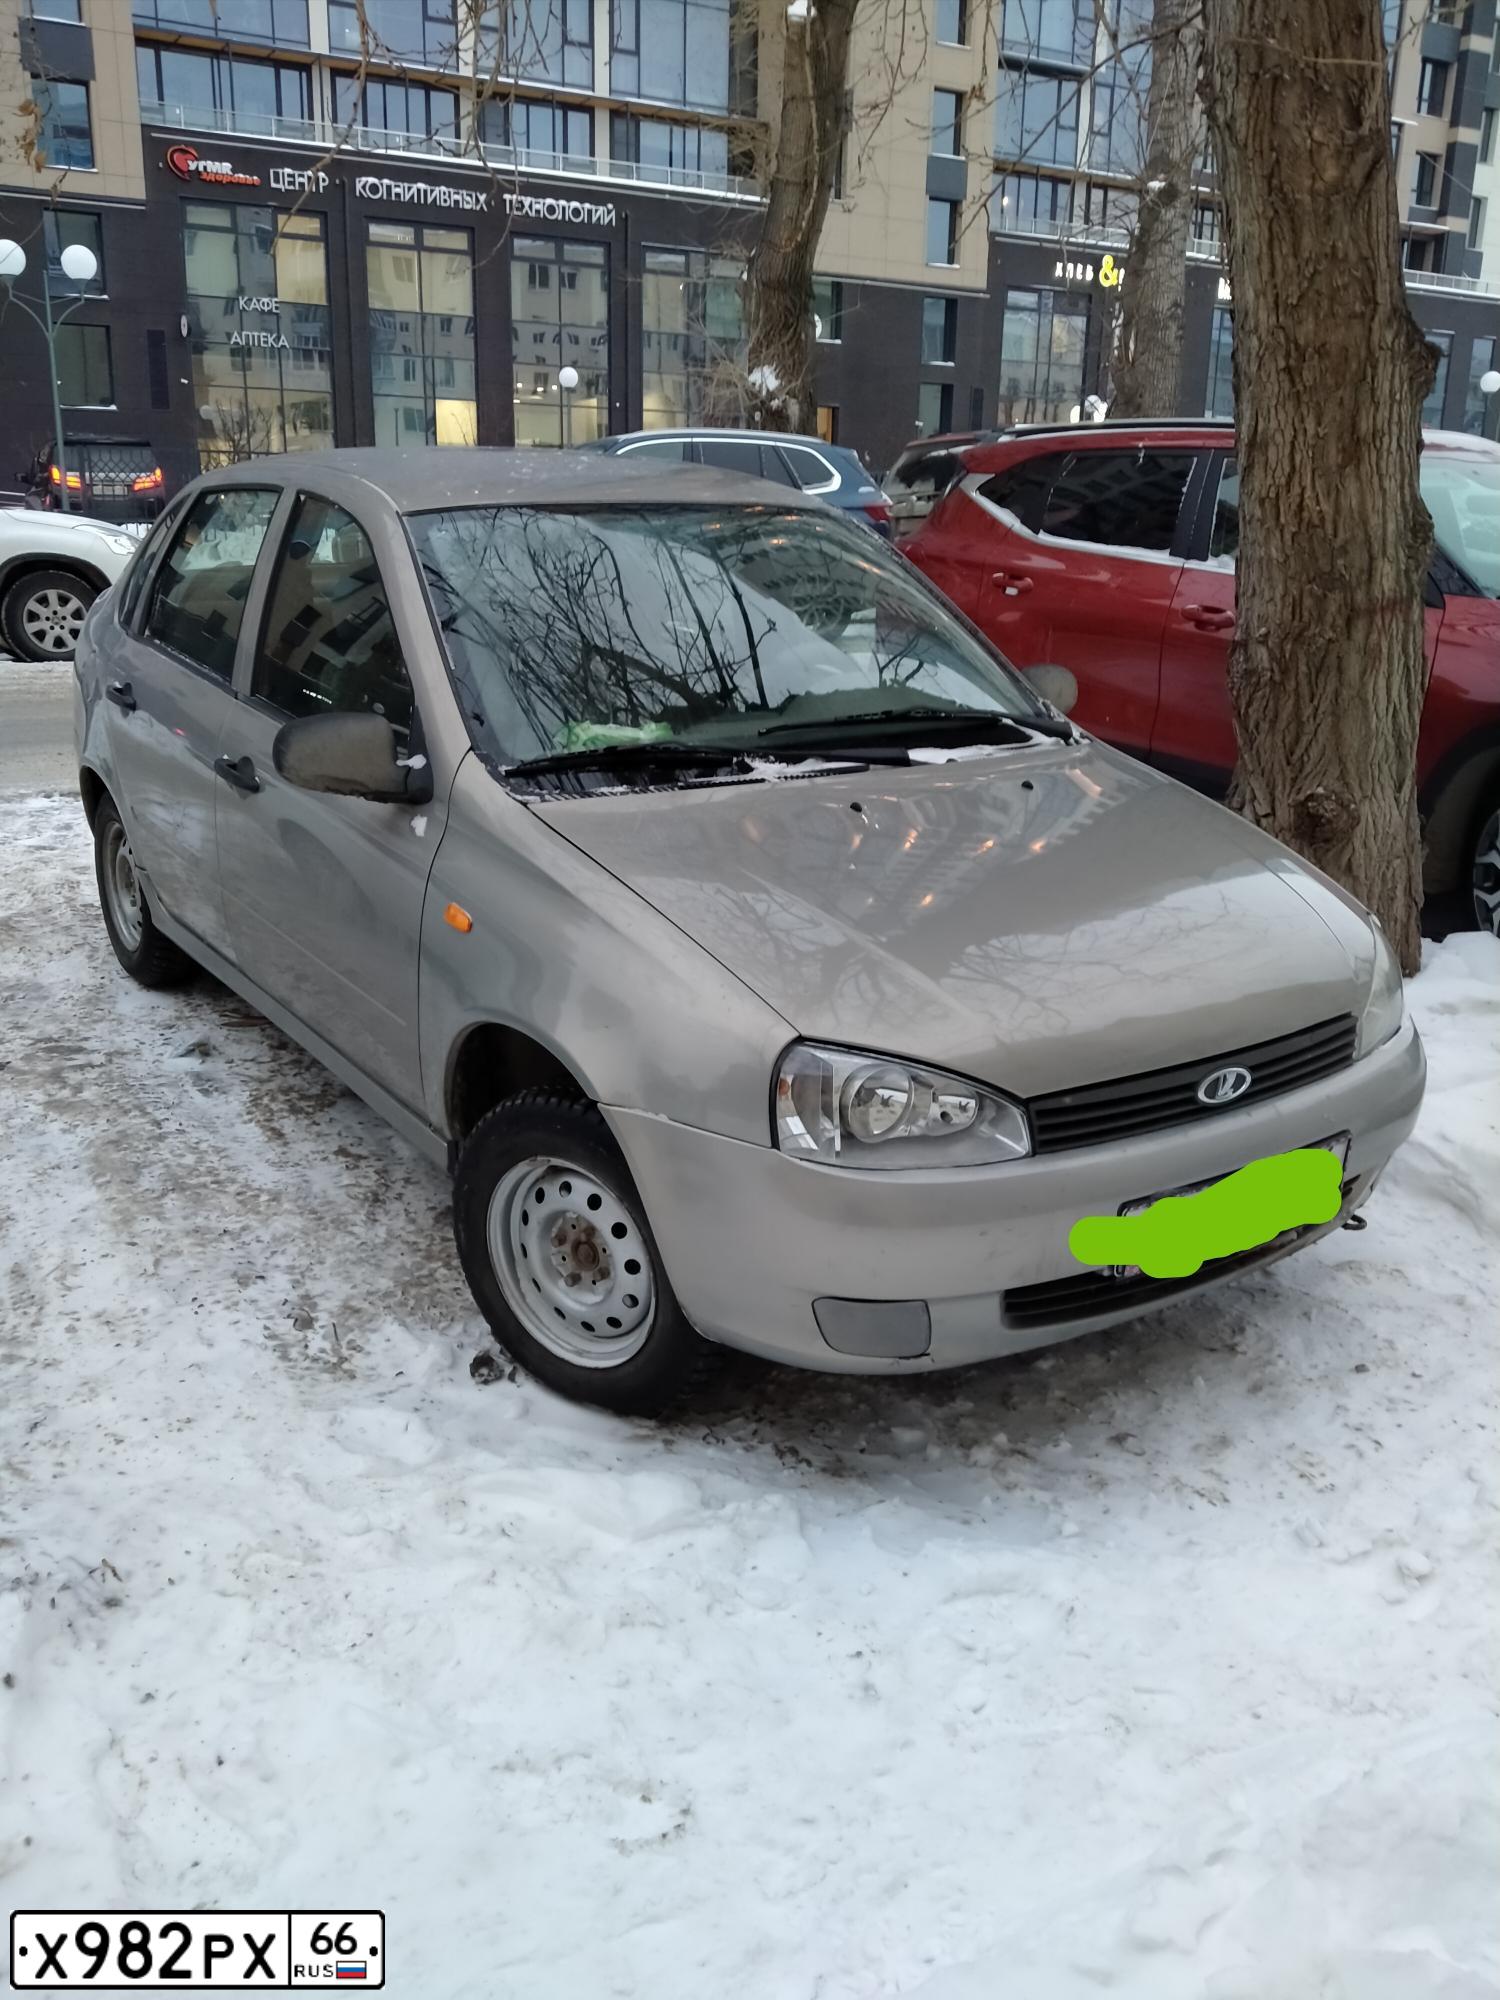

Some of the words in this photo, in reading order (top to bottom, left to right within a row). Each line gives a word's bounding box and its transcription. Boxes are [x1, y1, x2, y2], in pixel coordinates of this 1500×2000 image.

[270, 168, 329, 193] ЦЕНТР
[355, 176, 488, 212] КОГНИТИВНЫХ
[503, 193, 616, 227] ТЕХНОЛОГИЙ
[239, 296, 280, 313] КАФЕ
[230, 330, 290, 349] АПТЕКА
